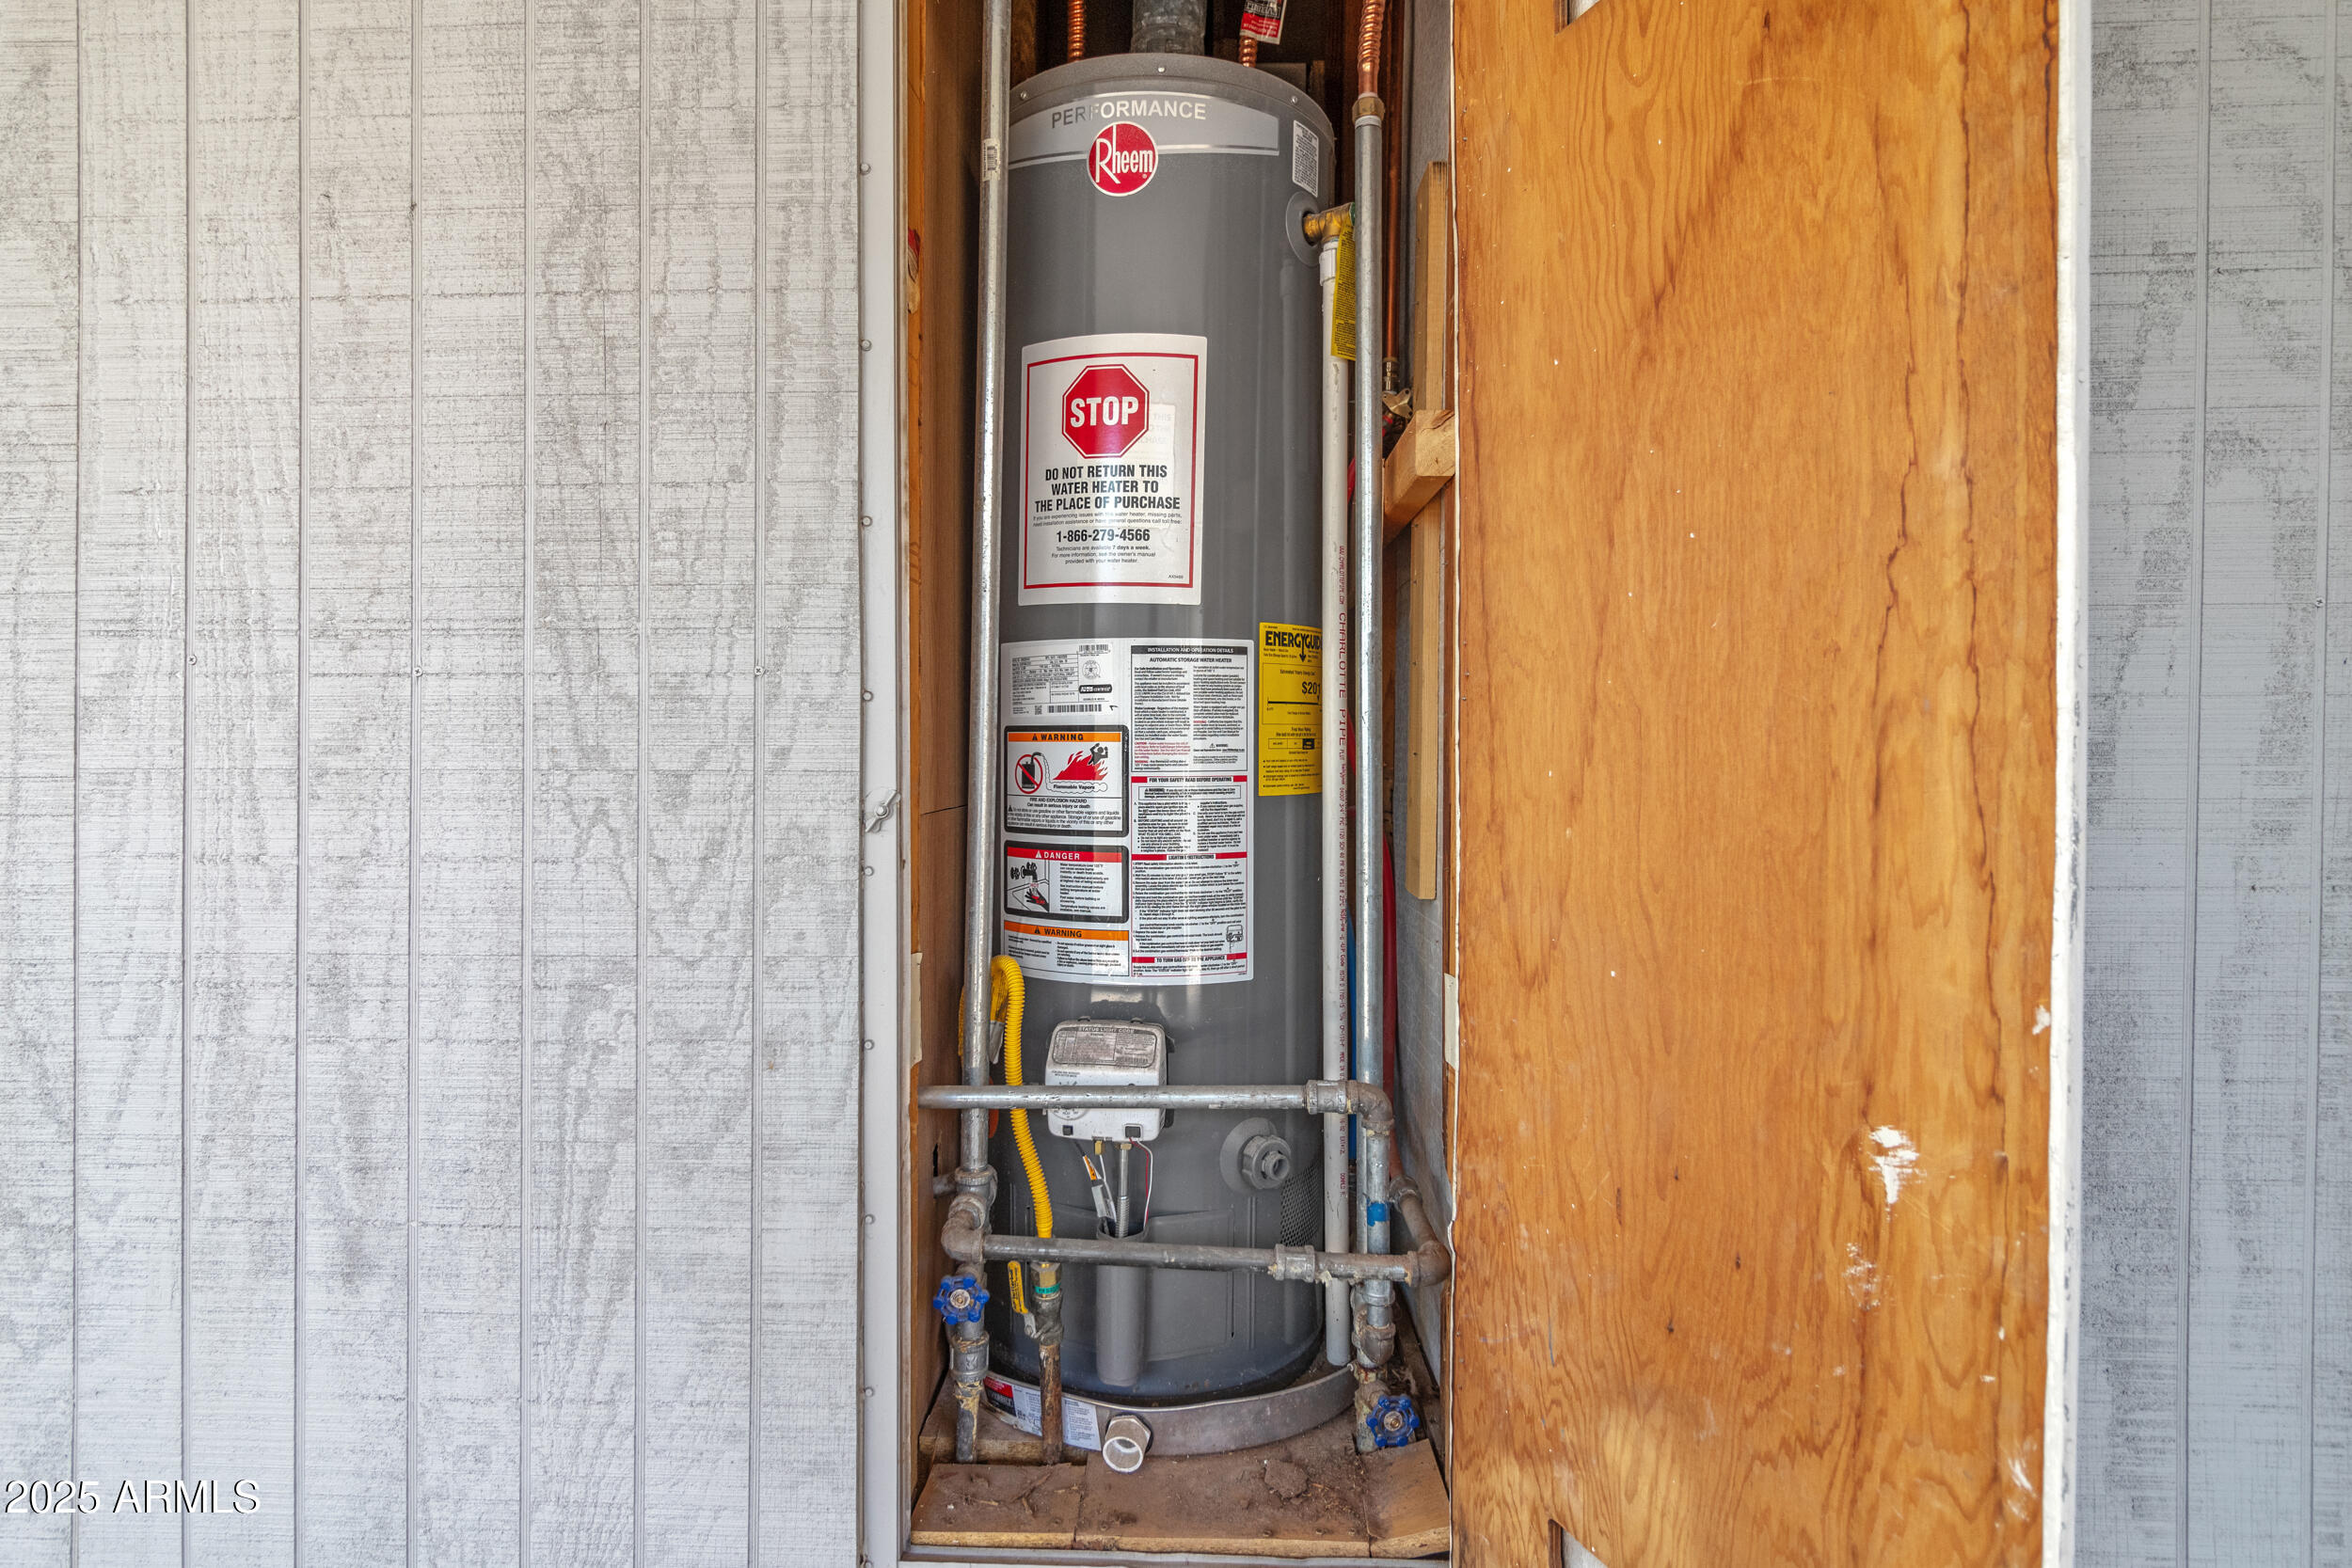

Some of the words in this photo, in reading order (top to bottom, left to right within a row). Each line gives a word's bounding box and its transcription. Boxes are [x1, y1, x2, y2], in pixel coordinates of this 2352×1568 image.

[1052, 100, 1206, 128] PERFORMANCE
[1095, 124, 1153, 184] Rheem
[1070, 395, 1139, 428] STOP
[1045, 469, 1058, 481] DO
[1062, 466, 1084, 479] NOT
[1087, 465, 1135, 478] RETURN
[1139, 465, 1167, 477] THIS
[1052, 482, 1088, 495] WATER
[1092, 480, 1138, 493] HEATER
[1143, 480, 1158, 493] TO
[1035, 500, 1052, 513] THE
[1056, 497, 1090, 510] PLACE
[1095, 496, 1109, 509] OF
[1114, 496, 1180, 509] PURCHASE
[1056, 529, 1150, 543] 1-866-279-4566
[1265, 631, 1321, 651] ENERGYGUID
[1044, 851, 1080, 860] DANGER
[1044, 928, 1082, 938] WARNING
